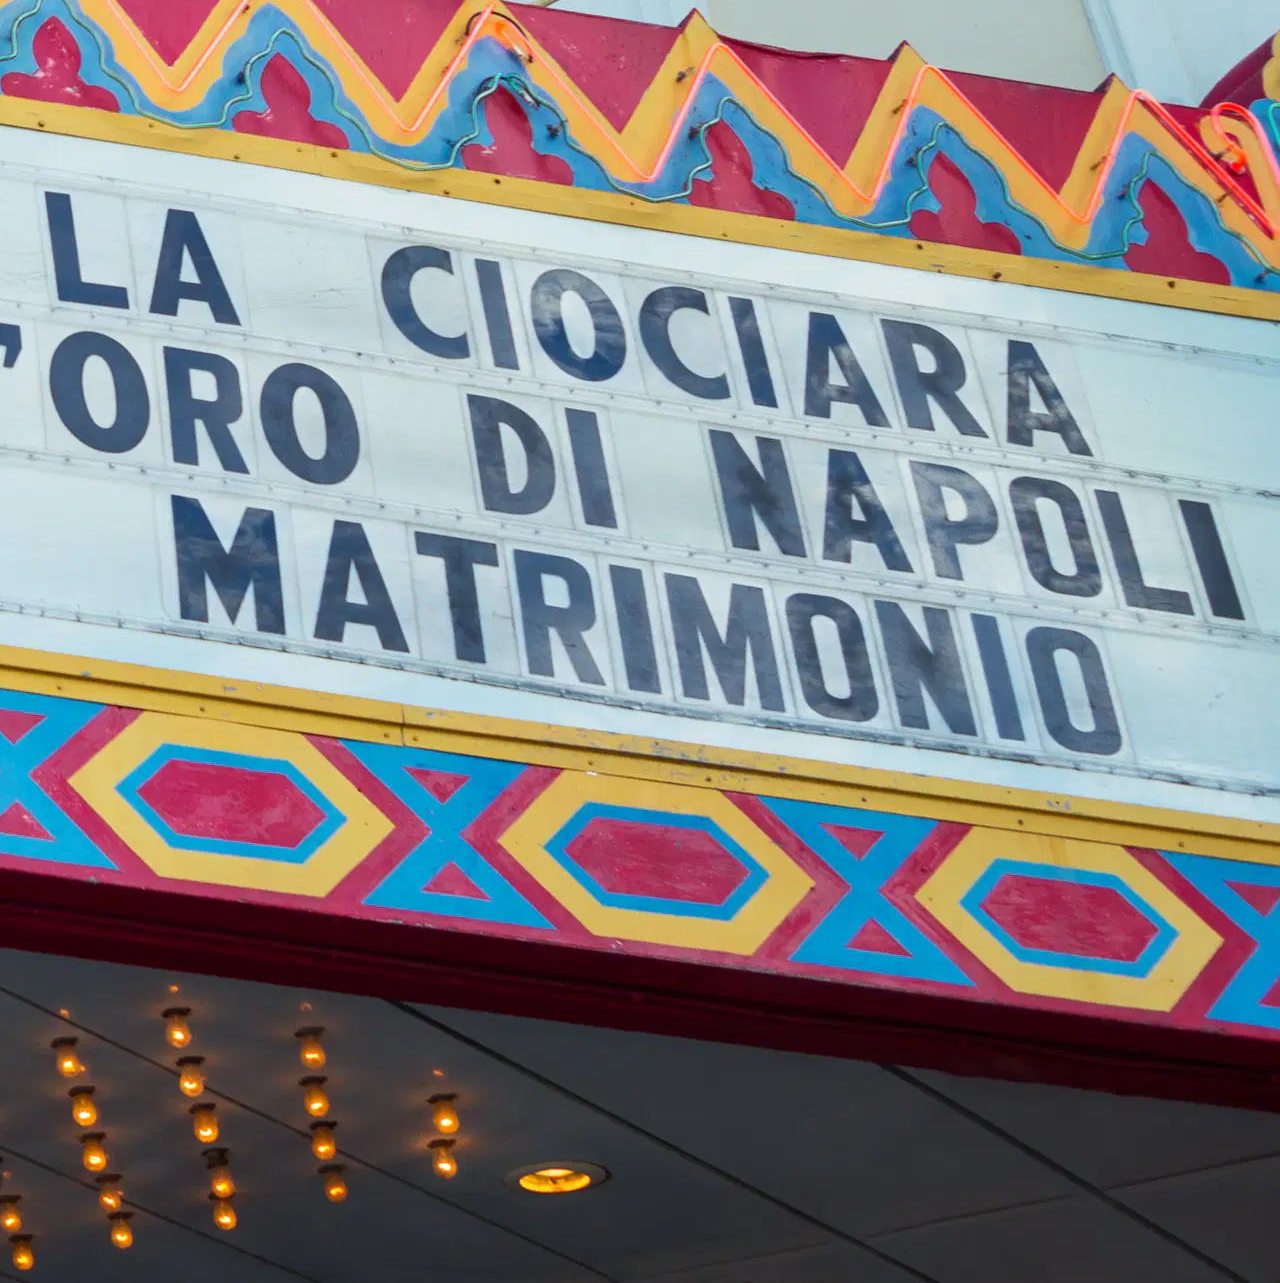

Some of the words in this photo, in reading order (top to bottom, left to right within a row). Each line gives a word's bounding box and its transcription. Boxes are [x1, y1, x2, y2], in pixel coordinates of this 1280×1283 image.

[45, 191, 241, 326] LA
[381, 246, 1093, 457] CIOCIARA
[171, 494, 1122, 755] MATRIMONIO
[467, 394, 617, 528] DI
[709, 429, 1245, 620] NAPOLI
